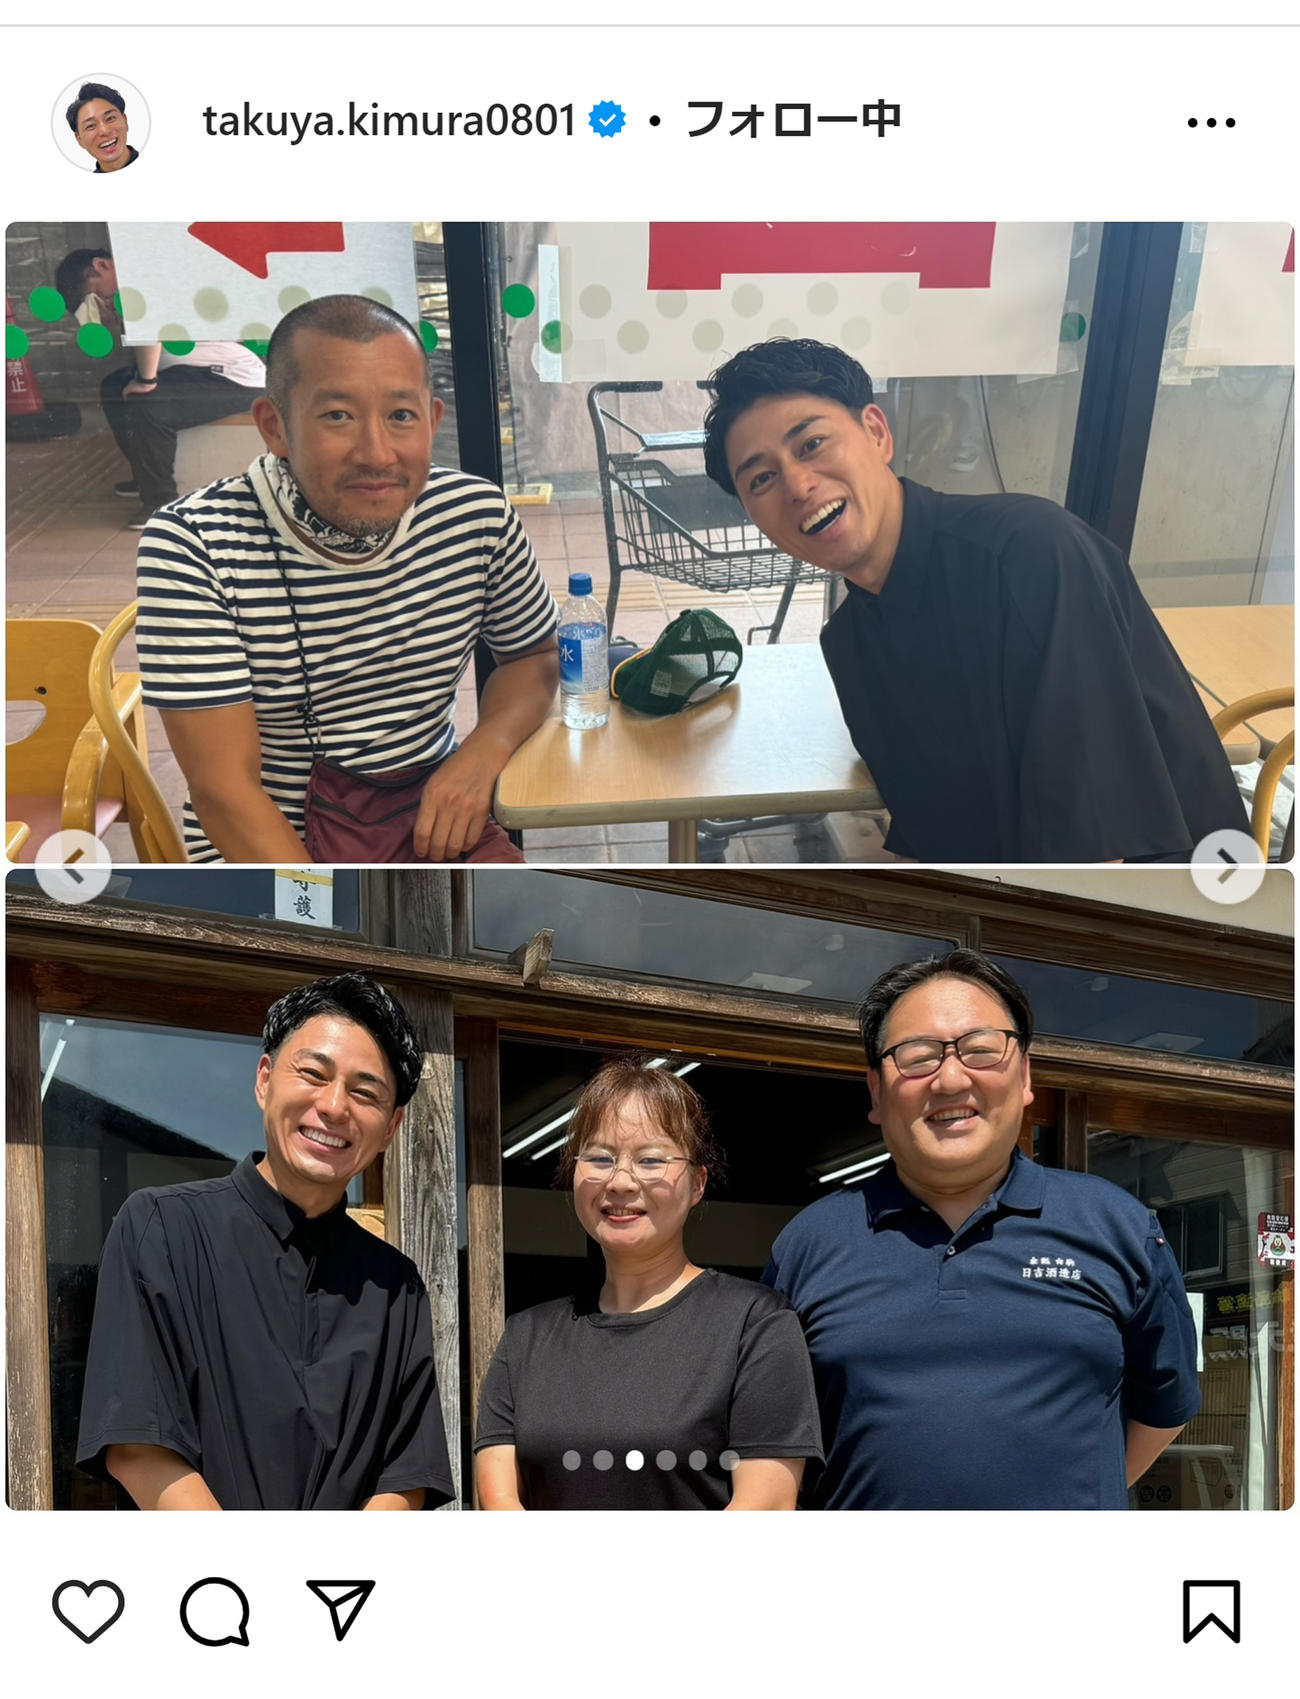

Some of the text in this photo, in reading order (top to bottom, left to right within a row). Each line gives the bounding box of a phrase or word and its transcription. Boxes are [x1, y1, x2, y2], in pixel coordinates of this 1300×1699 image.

[7, 360, 27, 392] 禁止
[1022, 1266, 1081, 1280] 日吉酒造店
